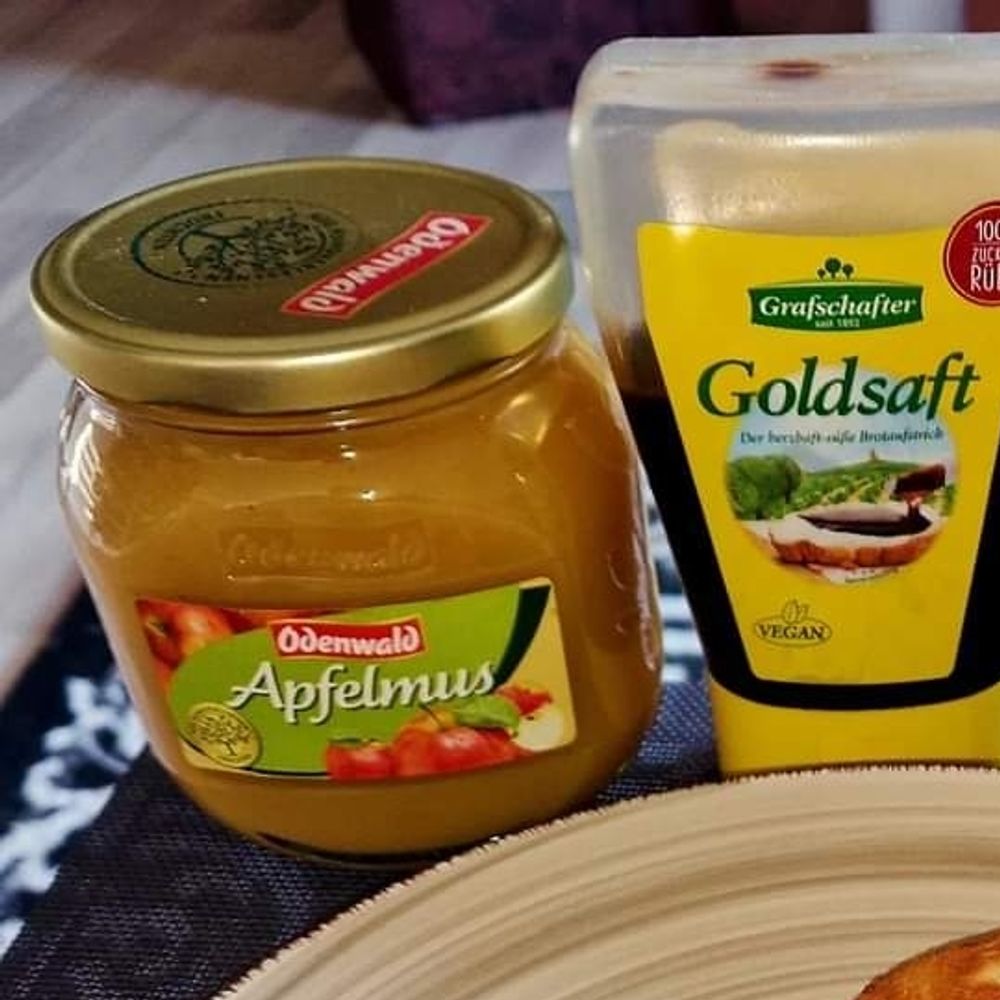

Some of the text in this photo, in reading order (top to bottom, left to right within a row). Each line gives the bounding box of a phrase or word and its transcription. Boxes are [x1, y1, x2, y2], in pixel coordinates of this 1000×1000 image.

[300, 216, 471, 313] Odenwald
[759, 294, 917, 321] Grafschafter
[697, 351, 981, 421] Goldsaft
[277, 624, 421, 657] Odenwald
[758, 623, 825, 640] VEGAN
[230, 659, 498, 726] Apfelmus
